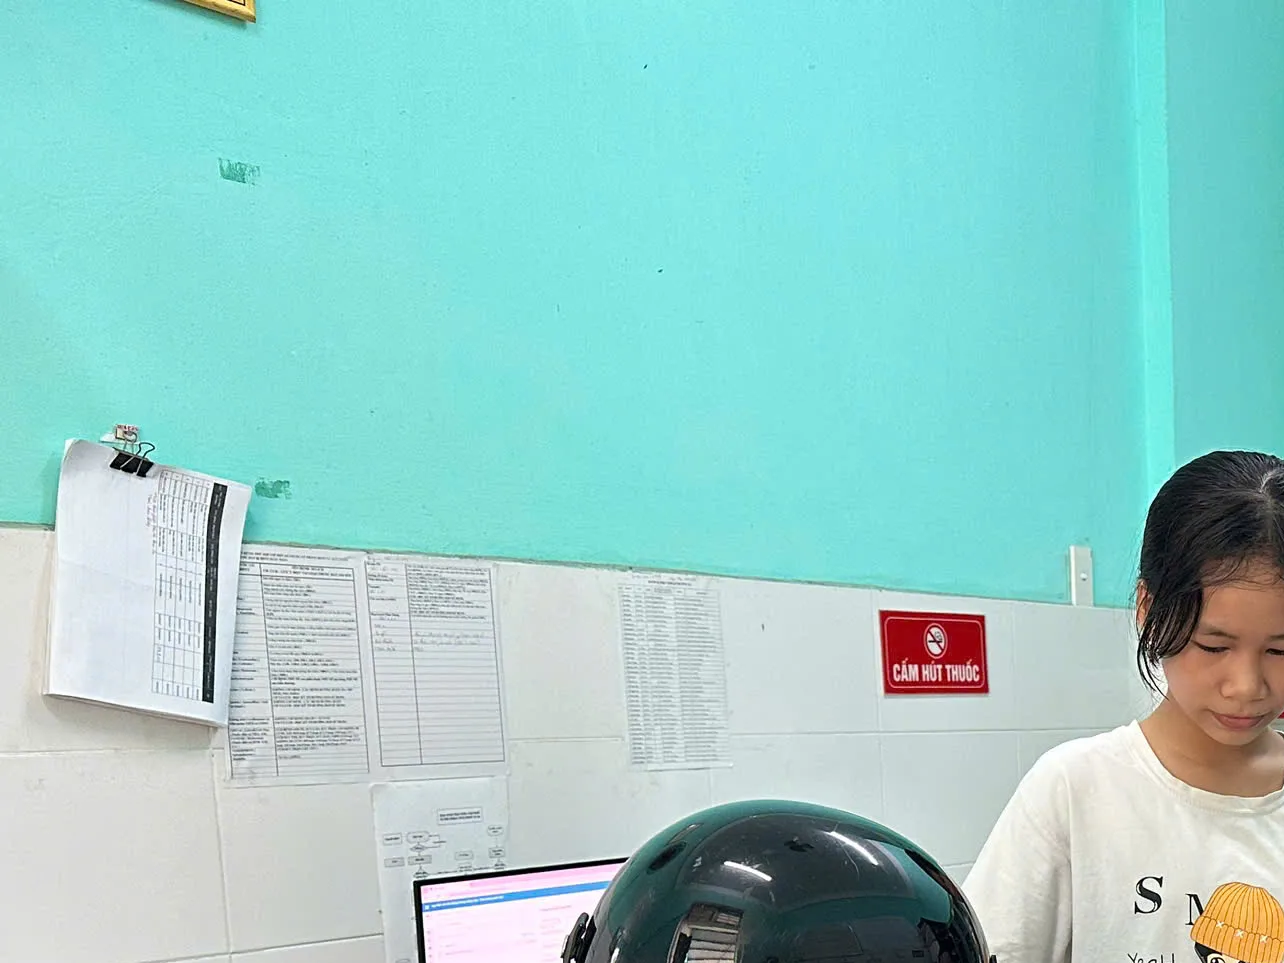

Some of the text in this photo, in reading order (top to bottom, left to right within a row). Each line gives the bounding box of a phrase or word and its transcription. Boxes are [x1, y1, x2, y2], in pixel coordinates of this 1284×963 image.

[893, 657, 980, 682] CẤM HÚT THUỐC
